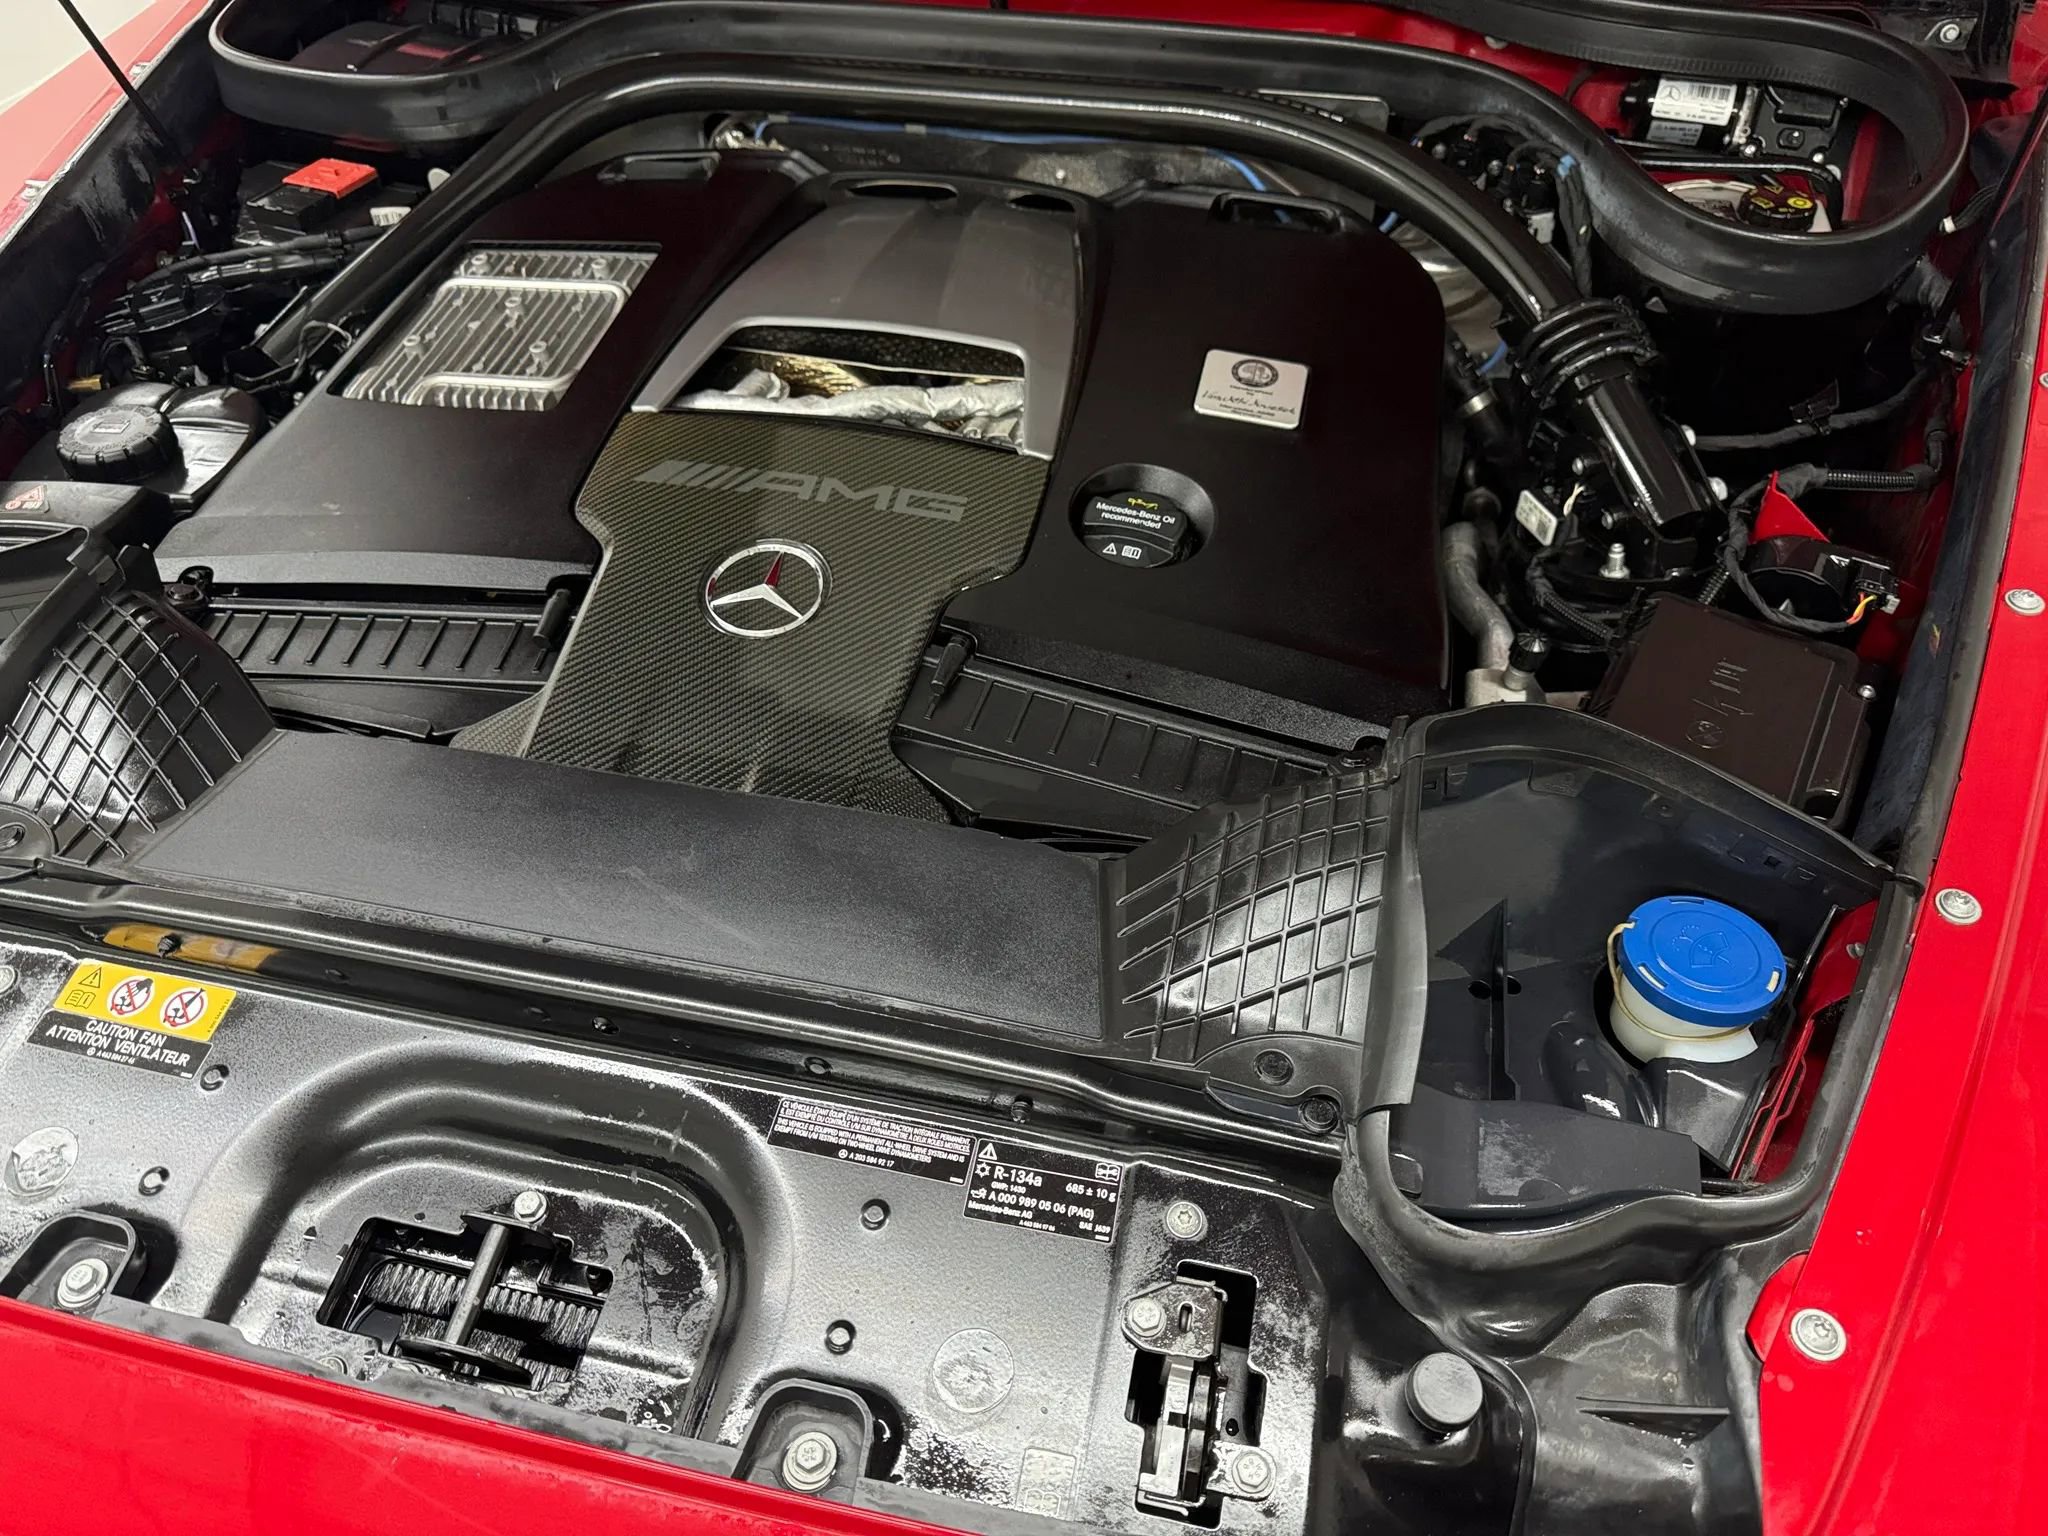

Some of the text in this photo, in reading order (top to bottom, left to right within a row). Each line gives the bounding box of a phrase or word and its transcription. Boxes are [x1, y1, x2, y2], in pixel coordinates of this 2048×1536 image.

[735, 468, 969, 522] AMG
[1096, 502, 1176, 525] Mercedes-Benz Oil
[1101, 511, 1161, 529] recommended
[45, 1024, 190, 1067] ATTENTION VENTILATEUR
[85, 1020, 167, 1048] CAUTION FAN
[782, 1100, 790, 1108] CE
[882, 1121, 889, 1129] DE
[890, 1122, 913, 1133] TRACTION
[785, 1109, 795, 1117] EST
[817, 1115, 825, 1123] DU
[861, 1125, 871, 1133] SUR
[913, 1135, 927, 1144] DEUX
[926, 1137, 943, 1148] ROUES
[774, 1124, 794, 1134] EXEMPT
[793, 1128, 809, 1138] FROM
[819, 1133, 839, 1144] TESTING
[838, 1137, 846, 1145] ON
[847, 1139, 875, 1152] TWO-WHEEL
[875, 1144, 891, 1155] DRIVE
[891, 1148, 932, 1163] DYNAMOMETERS
[777, 1117, 788, 1125] THIS
[788, 1119, 809, 1130] VEHICLE
[809, 1123, 814, 1131] IS
[814, 1124, 838, 1136] EQUIPPED
[839, 1130, 851, 1138] WITH
[856, 1133, 886, 1144] PERMANENT
[912, 1145, 927, 1155] DRIVE
[927, 1148, 947, 1159] SYSTEM
[947, 1152, 959, 1162] AND
[959, 1155, 965, 1163] IS
[848, 1152, 854, 1160] A
[854, 1153, 865, 1162] 203
[866, 1155, 877, 1164] 584
[878, 1158, 886, 1166] 92
[991, 1181, 1026, 1194] GWP: 1430
[994, 1165, 1043, 1187] R-134a
[1065, 1182, 1085, 1195] 685
[1096, 1187, 1108, 1199] 10
[1108, 1192, 1116, 1203] g
[967, 1199, 1033, 1219] Mercedes-Benz AG
[988, 1190, 1094, 1221] A 000 989 05 06 (PAG)
[1079, 1221, 1111, 1234] SAE J639
